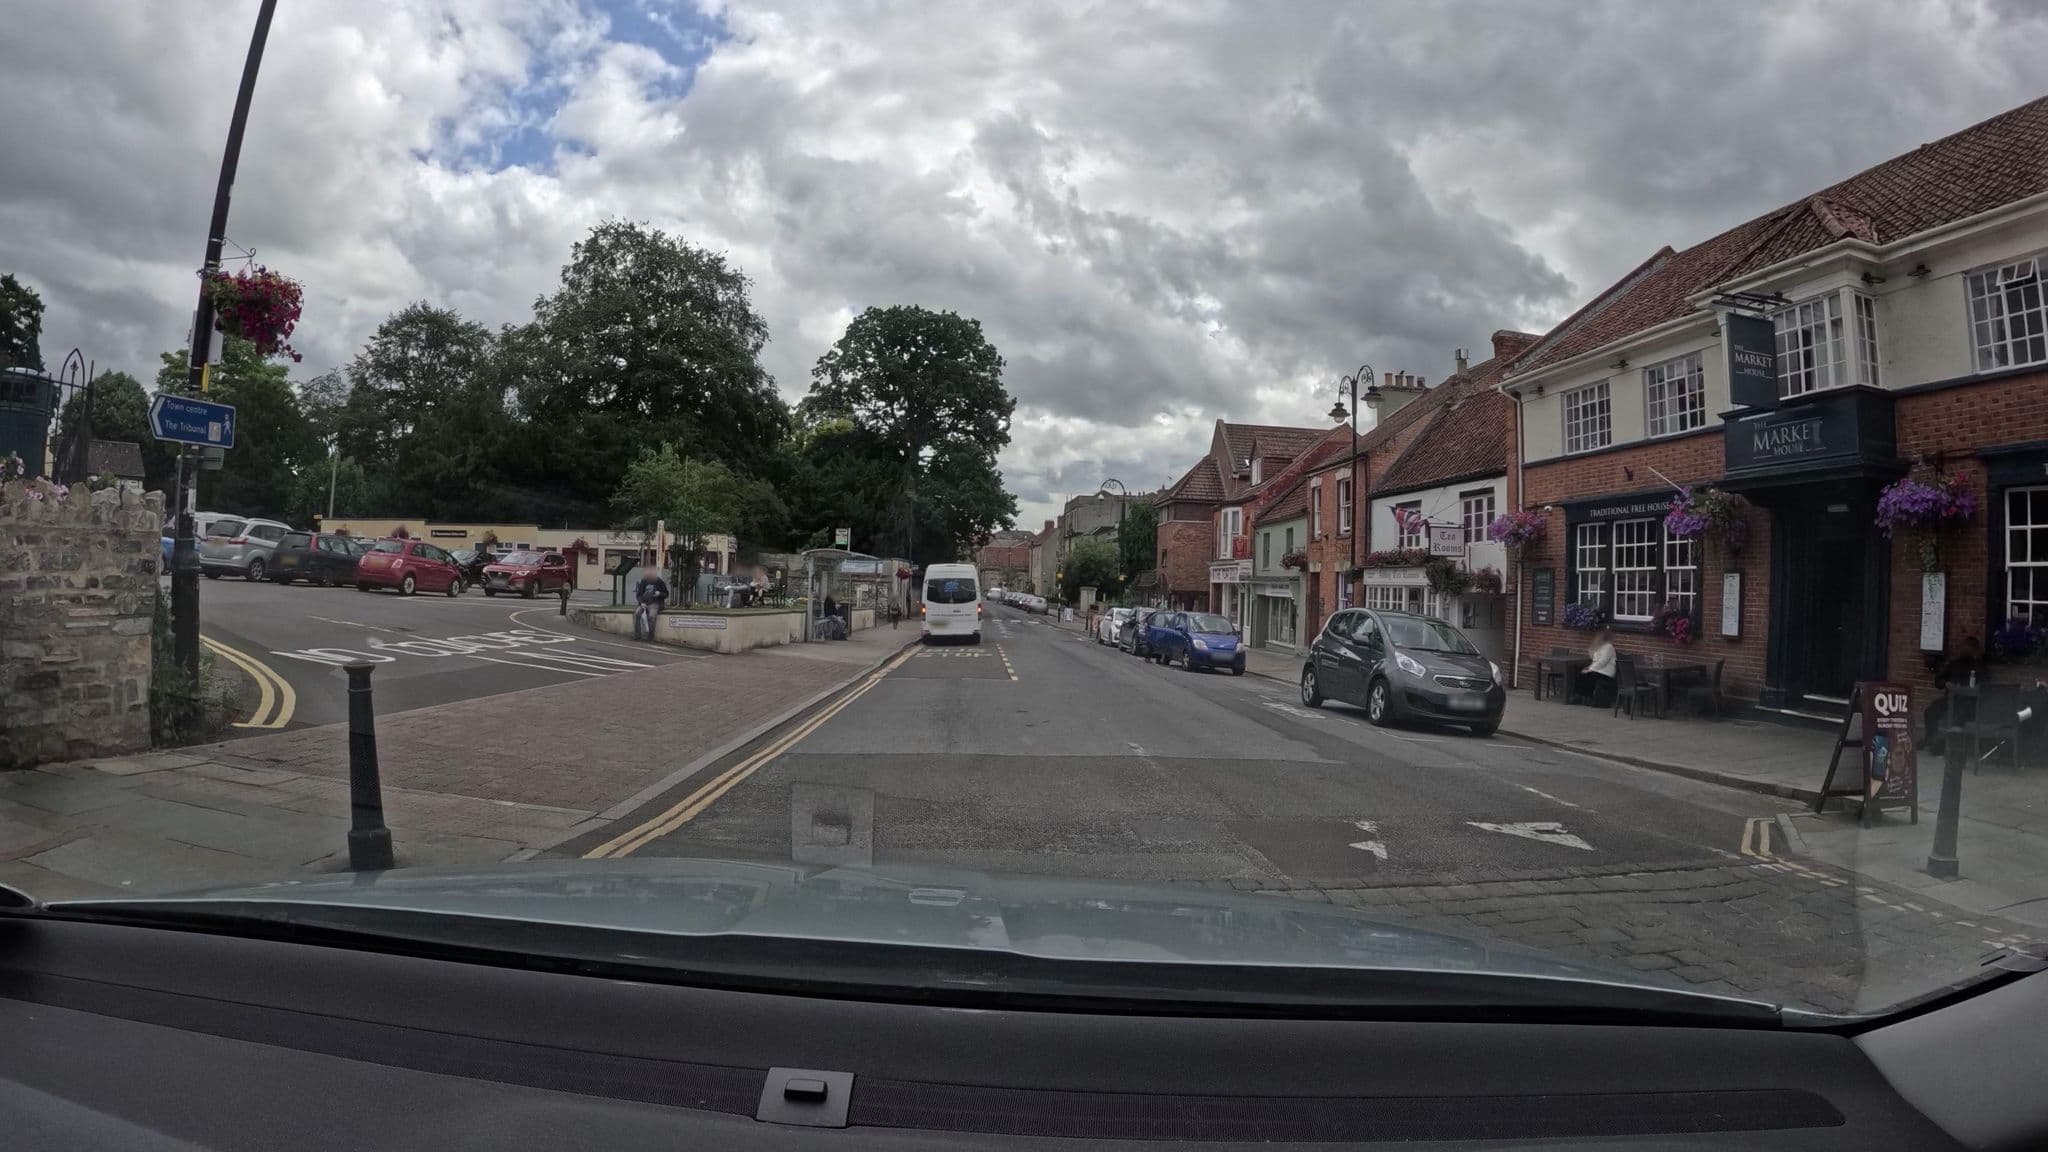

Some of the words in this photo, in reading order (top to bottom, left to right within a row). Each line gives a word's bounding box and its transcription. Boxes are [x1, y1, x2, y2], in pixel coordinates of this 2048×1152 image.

[1735, 352, 1772, 368] MARKET
[1743, 367, 1766, 377] HOUSE
[166, 399, 184, 411] Town
[185, 406, 208, 416] centre
[165, 419, 178, 430] The
[180, 421, 207, 434] Tribunal
[1589, 506, 1630, 517] TRADITIONAL
[1631, 503, 1647, 513] FREE
[1647, 501, 1671, 512] HOUSE
[1439, 531, 1456, 541] Tea
[1432, 543, 1463, 553] Rooms
[1874, 693, 1908, 716] QUIZ
